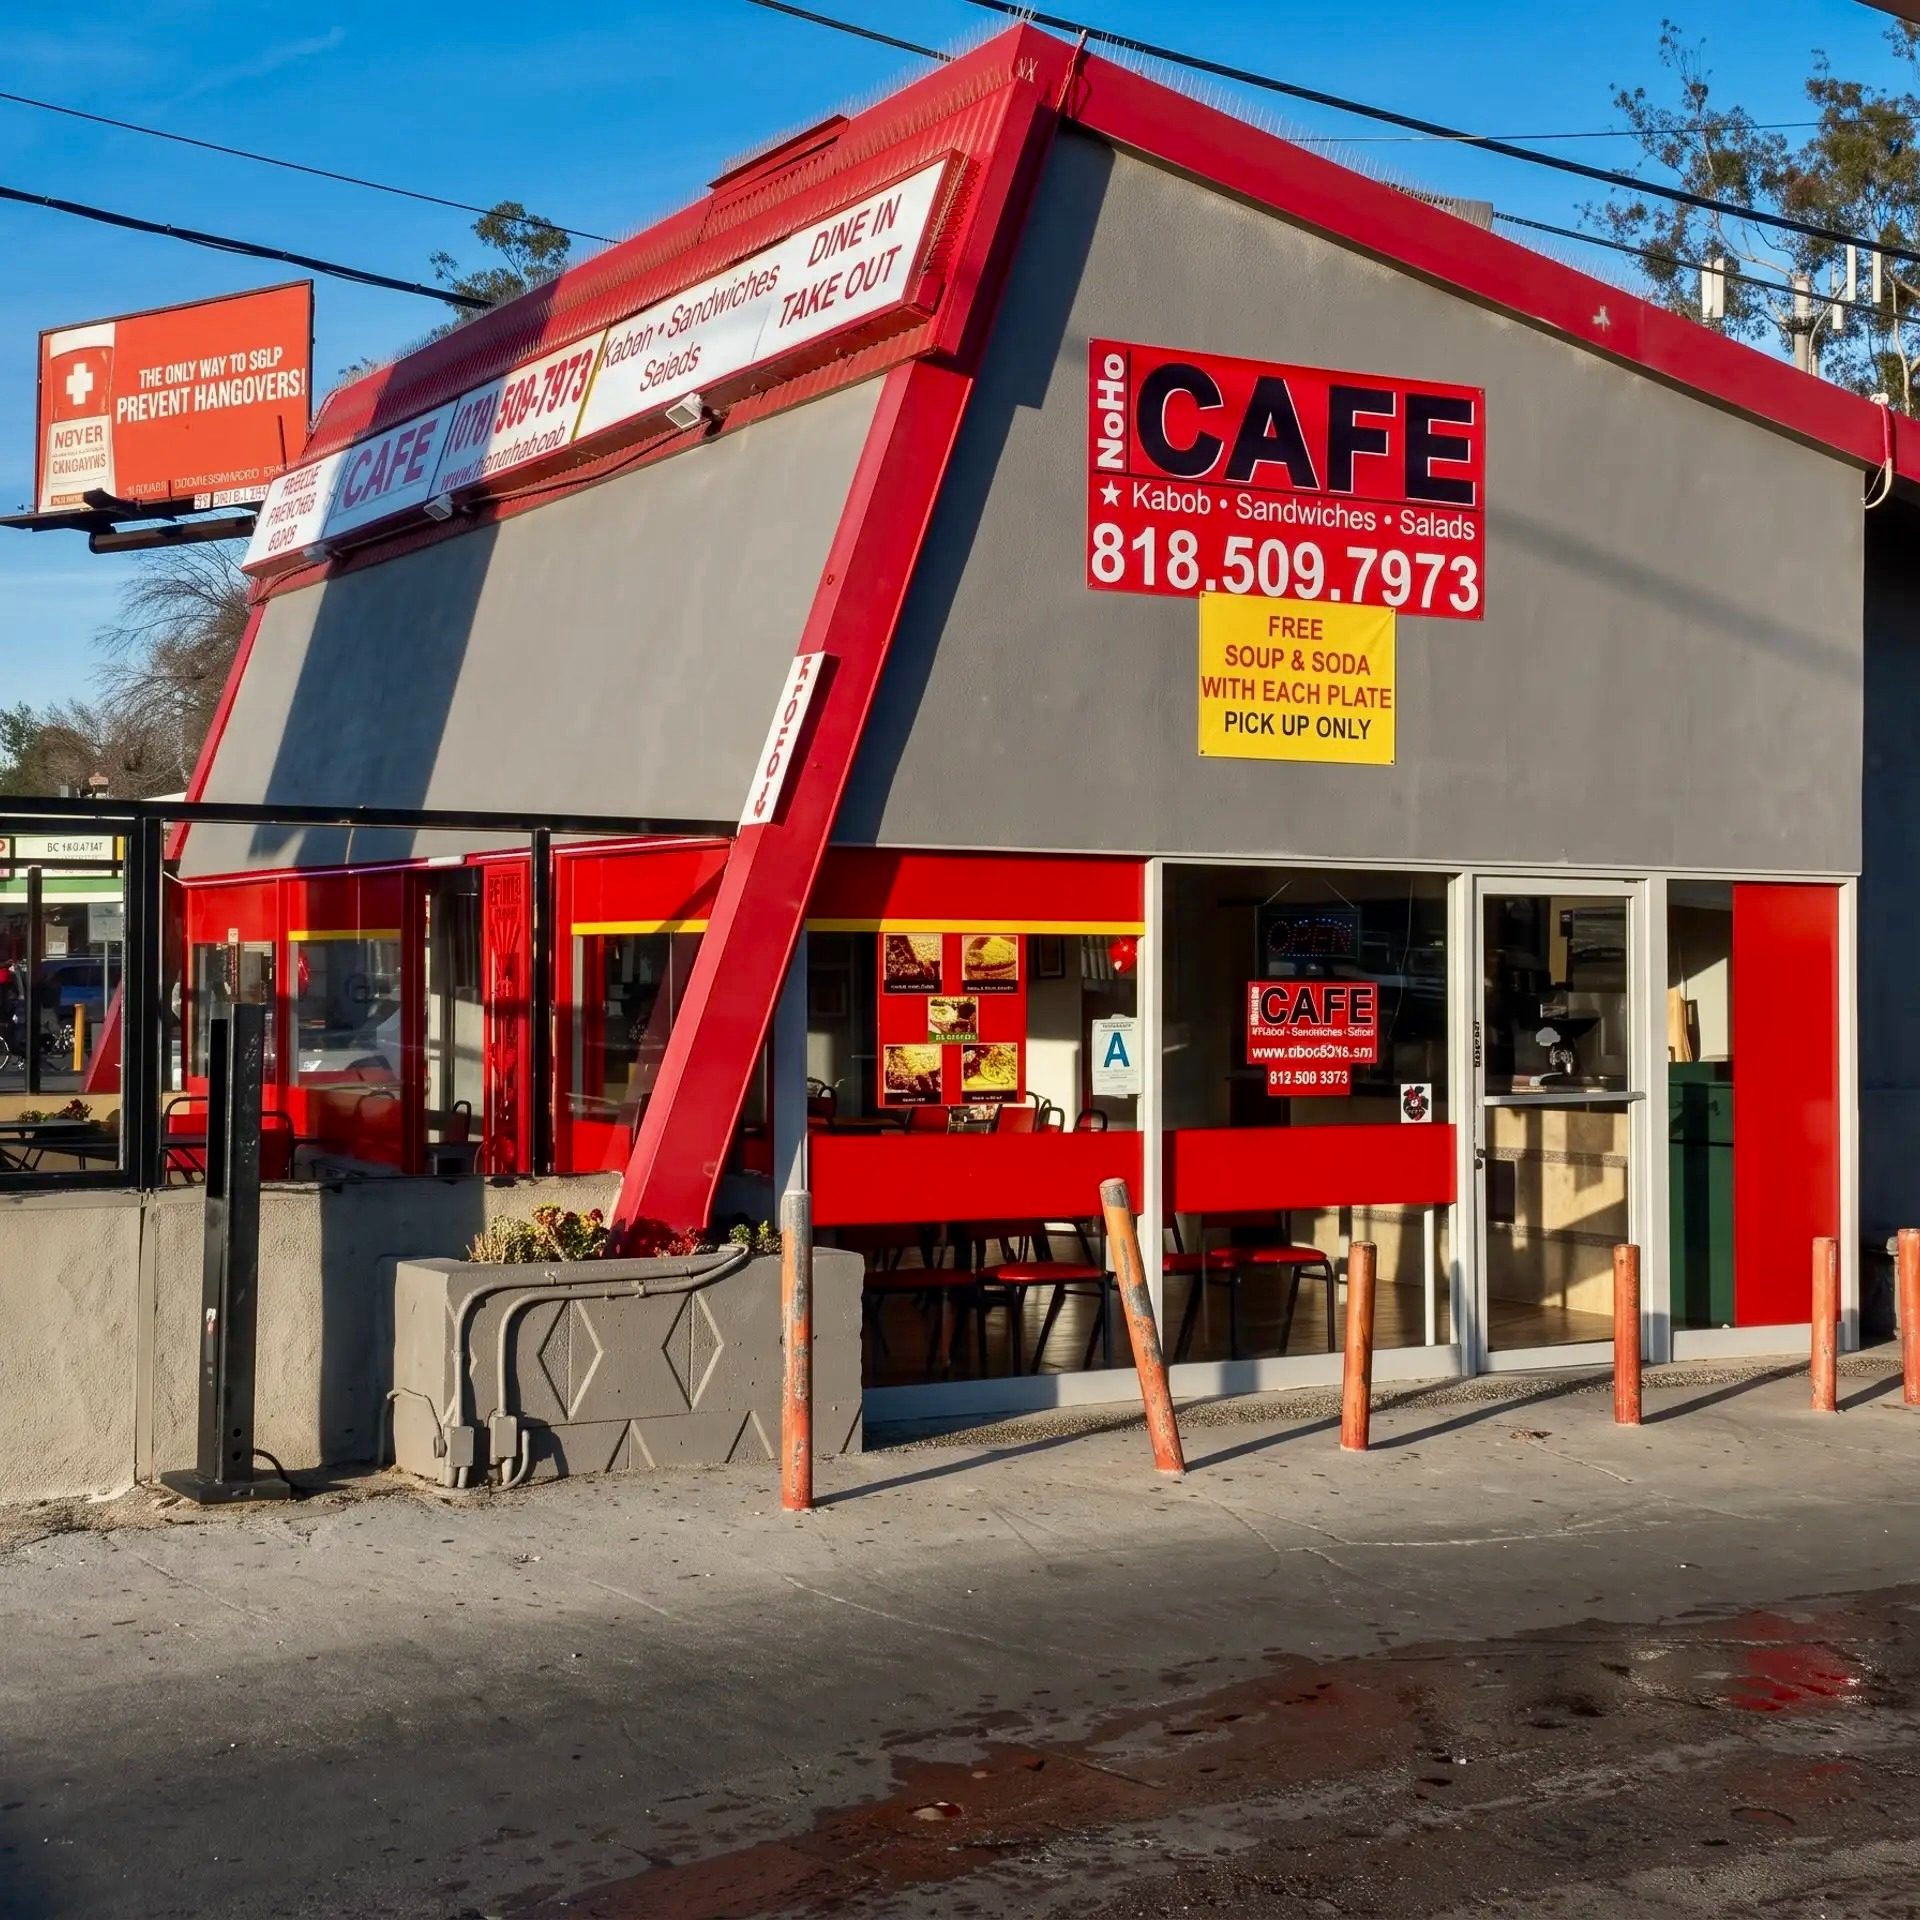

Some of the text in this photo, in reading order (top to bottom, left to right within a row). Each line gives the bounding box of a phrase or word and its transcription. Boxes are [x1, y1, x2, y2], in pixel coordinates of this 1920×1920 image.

[806, 193, 902, 268] DINE IN
[668, 263, 781, 335] Sandwiches
[779, 244, 902, 329] TAKE OUT
[117, 367, 305, 424] PREVENT HANGOVERS!
[139, 369, 162, 388] THE
[166, 361, 196, 385] ONLY
[200, 356, 226, 379] WAY
[230, 353, 246, 373] TO
[1097, 353, 1476, 506] NoHo CAFE
[342, 418, 439, 508] CAFE
[1133, 482, 1475, 541] Kabob Sandwiches Salads
[1091, 522, 1479, 612] 818.509.7973
[1268, 615, 1323, 641] FREE
[1224, 645, 1370, 676] SOUP & SODA
[1201, 676, 1391, 709] WITH EACH PLATE
[1224, 711, 1371, 740] PICK UP ONLY
[1260, 985, 1374, 1025] CAFE
[1103, 1031, 1131, 1068] A
